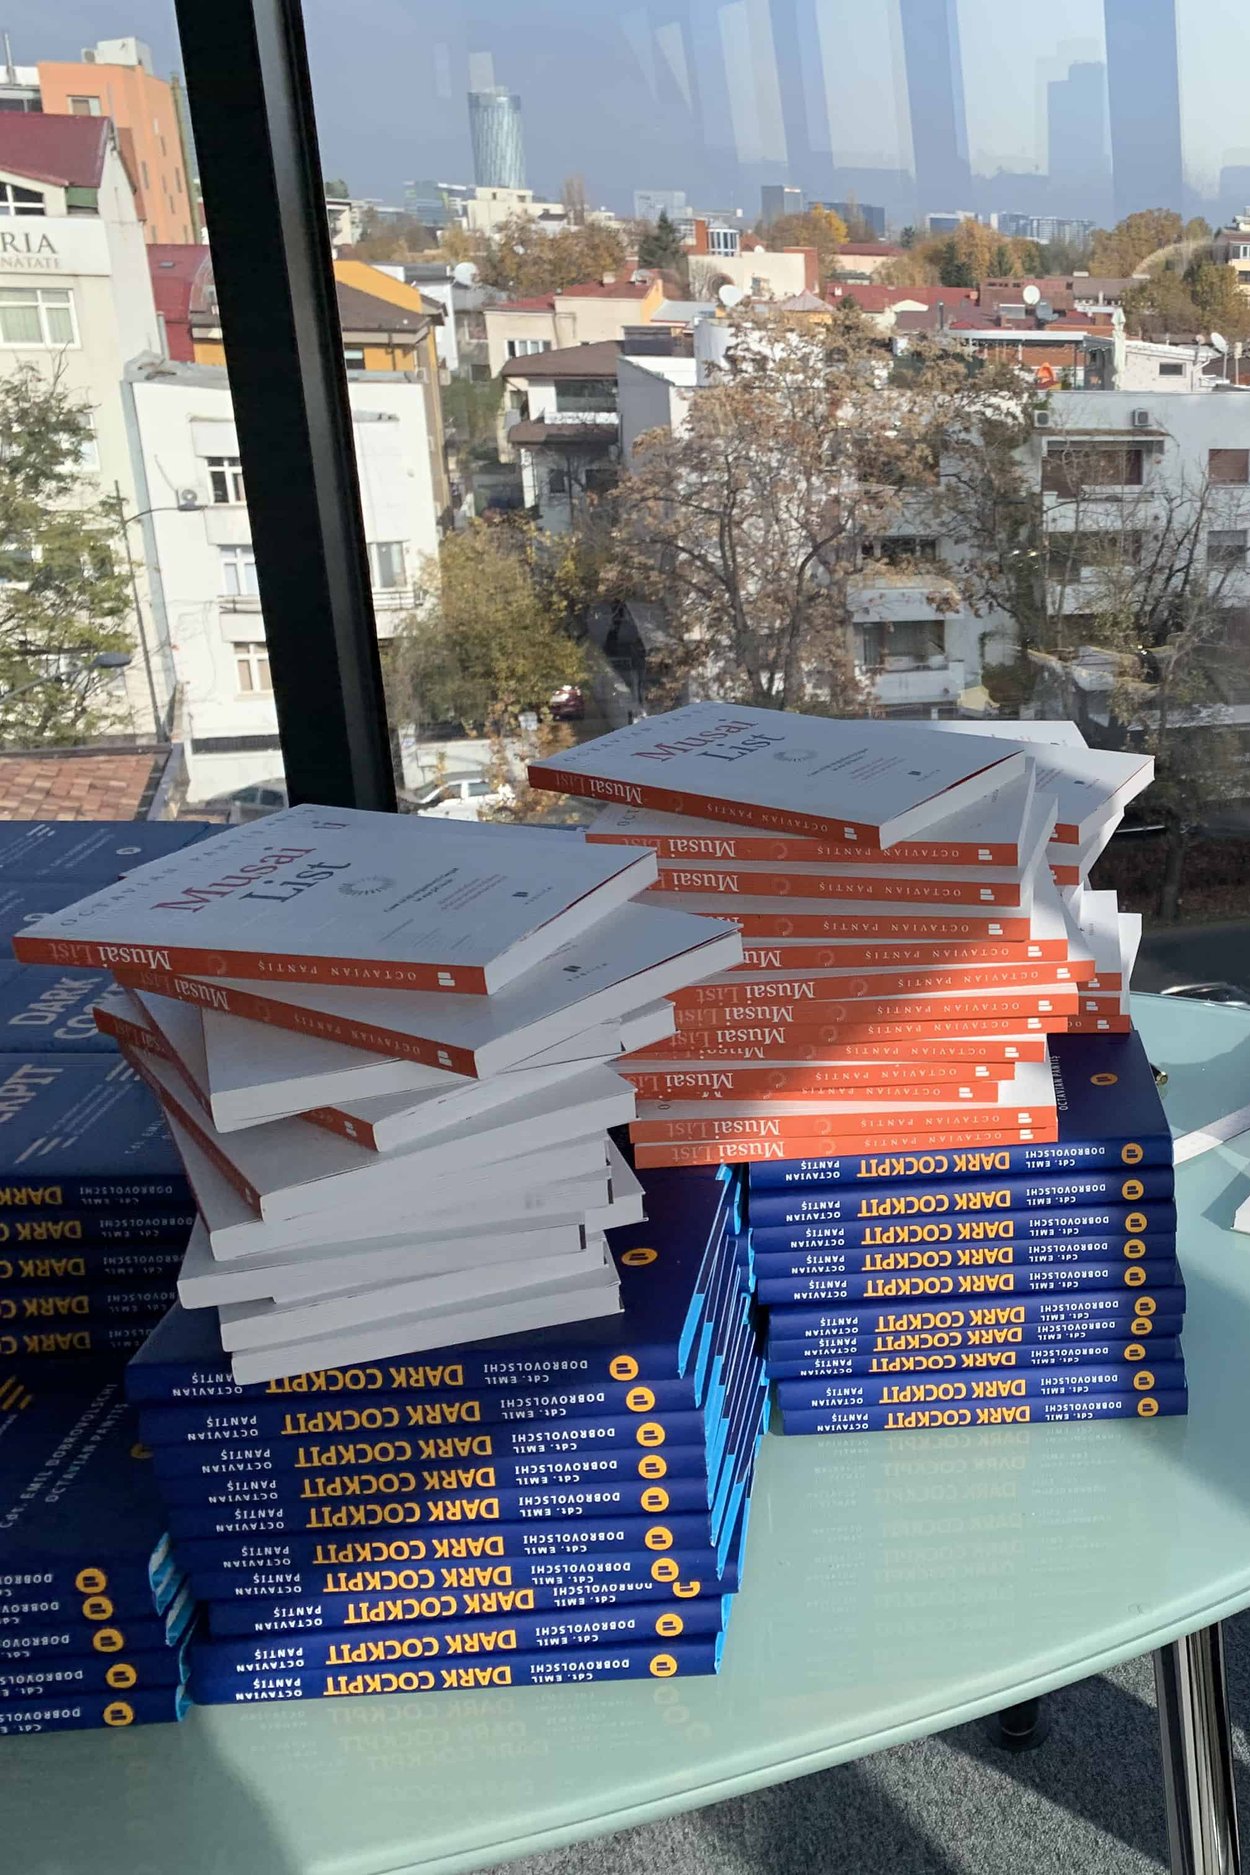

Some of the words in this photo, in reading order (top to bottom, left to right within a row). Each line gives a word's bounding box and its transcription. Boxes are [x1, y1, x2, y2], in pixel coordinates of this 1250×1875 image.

[631, 719, 758, 762] Musai
[696, 733, 785, 762] List
[589, 778, 643, 805] Musai
[760, 814, 828, 833] OCTAVIAN
[669, 839, 737, 858] Musai
[884, 848, 960, 859] OCTAVIAN
[151, 847, 316, 912] Musai
[239, 861, 351, 903] List
[672, 872, 740, 891] Musai
[885, 886, 961, 897] OCTAVIAN
[891, 923, 969, 933] OCTAVIAN
[97, 946, 173, 971] Musai
[933, 947, 1009, 958] OCTAVIAN
[331, 967, 417, 982] OCTAVIAN
[964, 972, 1038, 984] OCTAVIAN
[8, 976, 103, 1026] DARK
[174, 979, 230, 1012] Musai
[745, 982, 815, 1004] Musai
[725, 1005, 794, 1025] Musai
[944, 1002, 1019, 1013] OCTAVIAN
[934, 1020, 1009, 1031] OCTAVIAN
[717, 1027, 786, 1048] Musai
[882, 1068, 957, 1078] OCTAVIAN
[665, 1073, 734, 1093] Musai
[925, 1115, 999, 1125] OCTAVIAN
[713, 1119, 781, 1139] Musai
[929, 1132, 1002, 1143] OCTAVIAN
[718, 1141, 784, 1162] Musai
[1026, 1147, 1105, 1158] DOBROVOLSCHI
[857, 1156, 948, 1177] COCKPIT
[955, 1152, 1010, 1170] DARK
[786, 1171, 840, 1181] OCTAVIAN
[1027, 1184, 1106, 1196] DOBROVOLSCHI
[857, 1194, 949, 1217] COCKPIT
[954, 1190, 1011, 1210] DARK
[786, 1211, 840, 1222] OCTAVIAN
[1029, 1216, 1109, 1227] DOBROVOLSCHI
[16, 1220, 82, 1240] DARK
[861, 1224, 952, 1244] COCKPIT
[958, 1221, 1013, 1239] DARK
[791, 1239, 845, 1248] OCTAVIAN
[1029, 1243, 1107, 1254] DOBROVOLSCHI
[861, 1251, 952, 1271] COCKPIT
[958, 1247, 1013, 1264] DARK
[20, 1258, 85, 1278] DARK
[792, 1265, 845, 1274] OCTAVIAN
[1030, 1270, 1108, 1281] DOBROVOLSCHI
[863, 1277, 952, 1297] COCKPIT
[960, 1274, 1014, 1291] DARK
[794, 1291, 847, 1300] OCTAVIAN
[23, 1295, 89, 1317] DARK
[1040, 1301, 1118, 1312] DOBROVOLSCHI
[874, 1312, 964, 1332] COCKPIT
[971, 1306, 1025, 1324] DARK
[805, 1327, 858, 1337] OCTAVIAN
[969, 1327, 1022, 1344] DARK
[1038, 1322, 1115, 1333] DOBROVOLSCHI
[23, 1331, 91, 1353] DARK
[873, 1332, 962, 1352] COCKPIT
[804, 1347, 857, 1356] OCTAVIAN
[963, 1352, 1016, 1367] DARK
[1031, 1347, 1108, 1358] DOBROVOLSCHI
[484, 1360, 587, 1372] DOBROVOLSCHI
[801, 1368, 852, 1376] OCTAVIAN
[868, 1355, 956, 1373] COCKPIT
[390, 1366, 463, 1387] DARK
[485, 1376, 517, 1384] EMIL
[1041, 1375, 1118, 1386] DOBROVOLSCHI
[172, 1386, 243, 1396] OCTAVIAN
[879, 1383, 966, 1404] COCKPIT
[972, 1379, 1026, 1397] DARK
[501, 1393, 604, 1408] DOBROVOLSCHI
[812, 1398, 863, 1407] OCTAVIAN
[1045, 1402, 1122, 1413] DOBROVOLSCHI
[281, 1408, 399, 1434] COCKPIT
[407, 1402, 480, 1424] DARK
[502, 1409, 534, 1419] EMIL
[884, 1410, 971, 1429] COCKPIT
[977, 1405, 1031, 1423] DARK
[188, 1429, 258, 1440] OCTAVIAN
[512, 1428, 615, 1442] DOBROVOLSCHI
[817, 1423, 868, 1432] OCTAVIAN
[295, 1442, 412, 1468] COCKPIT
[420, 1436, 491, 1457] DARK
[513, 1444, 545, 1453] EMIL
[202, 1462, 271, 1473] OCTAVIAN
[515, 1460, 617, 1474] DOBROVOLSCHI
[301, 1473, 416, 1498] COCKPIT
[423, 1468, 495, 1489] DARK
[516, 1476, 548, 1485] EMIL
[209, 1493, 277, 1503] OCTAVIAN
[519, 1492, 620, 1506] DOBROVOLSCHI
[306, 1503, 421, 1528] COCKPIT
[428, 1498, 500, 1520] DARK
[520, 1508, 551, 1517] EMIL
[216, 1522, 284, 1532] OCTAVIAN
[523, 1531, 624, 1544] DOBROVOLSCHI
[313, 1542, 427, 1564] COCKPIT
[433, 1536, 505, 1559] DARK
[223, 1558, 290, 1567] OCTAVIAN
[531, 1562, 630, 1574] DOBROVOLSCHI
[323, 1570, 434, 1592] COCKPIT
[442, 1566, 512, 1587] DARK
[236, 1586, 301, 1595] OCTAVIAN
[464, 1589, 534, 1612] DARK
[343, 1596, 456, 1624] COCKPIT
[255, 1618, 322, 1631] OCTAVIAN
[536, 1619, 635, 1636] DOBROVOLSCHI
[448, 1630, 517, 1654] DARK
[326, 1639, 439, 1665] COCKPIT
[237, 1659, 304, 1672] OCTAVIAN
[531, 1659, 629, 1673] DOBROVOLSCHI
[323, 1671, 434, 1695] COCKPIT
[442, 1666, 512, 1687] DARK
[236, 1689, 302, 1700] OCTAVIAN
